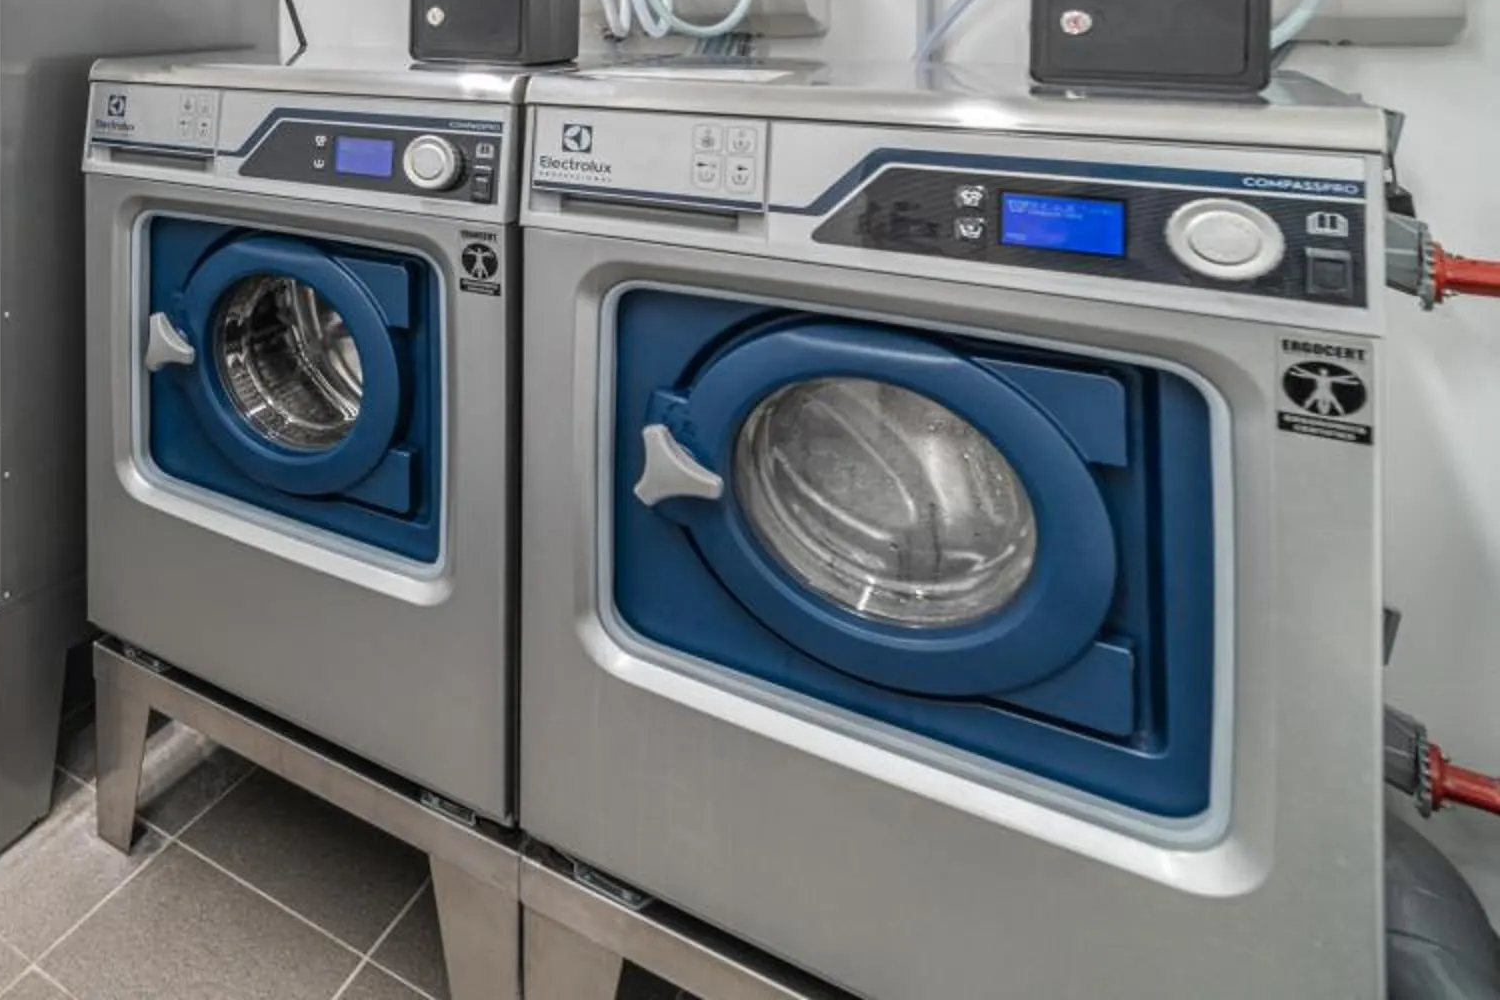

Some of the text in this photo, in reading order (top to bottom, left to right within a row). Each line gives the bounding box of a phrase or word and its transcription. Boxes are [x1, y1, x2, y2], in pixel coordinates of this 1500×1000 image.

[539, 155, 612, 173] Electrolux
[1243, 177, 1360, 195] COMPASSPRO
[1282, 339, 1365, 361] ERGOCERT
